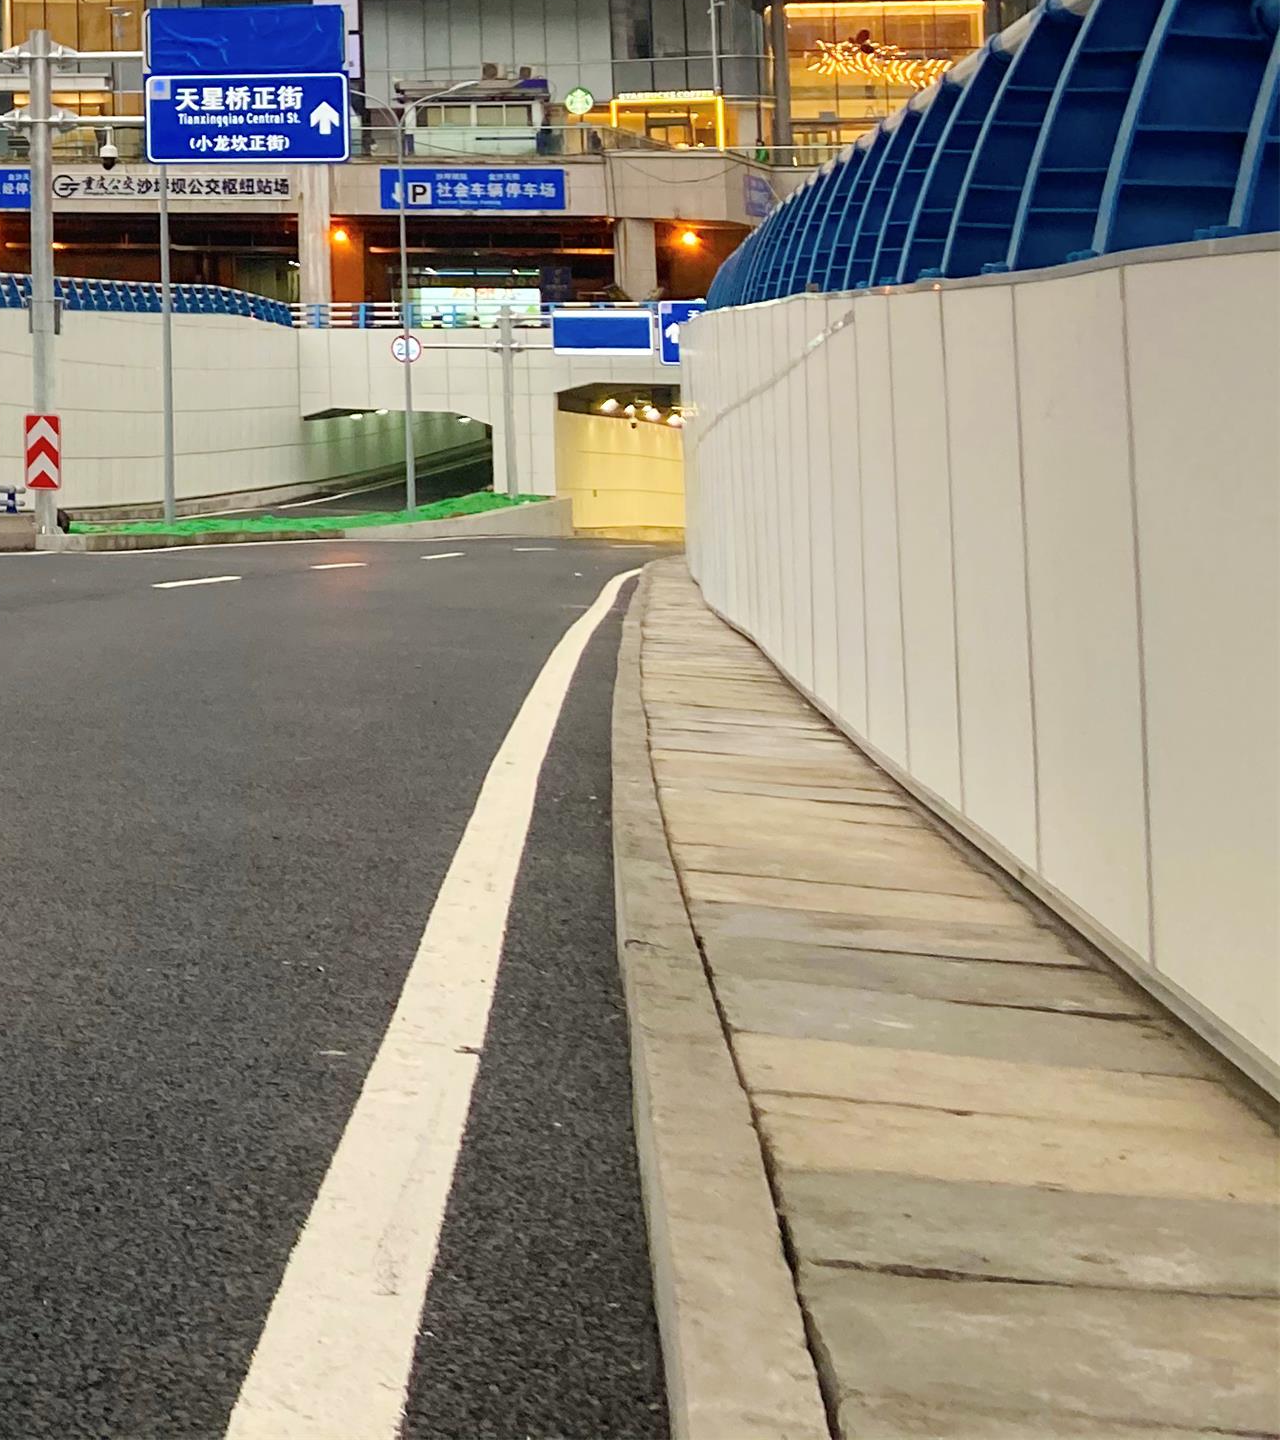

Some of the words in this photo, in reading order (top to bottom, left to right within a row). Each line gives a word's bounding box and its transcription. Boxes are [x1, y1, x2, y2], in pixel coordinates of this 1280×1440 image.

[175, 85, 304, 111] 天星桥正街
[178, 113, 244, 127] Tianxingqiao
[246, 112, 284, 124] Central
[287, 112, 301, 124] St.
[436, 182, 556, 198] 社会车辆停车场
